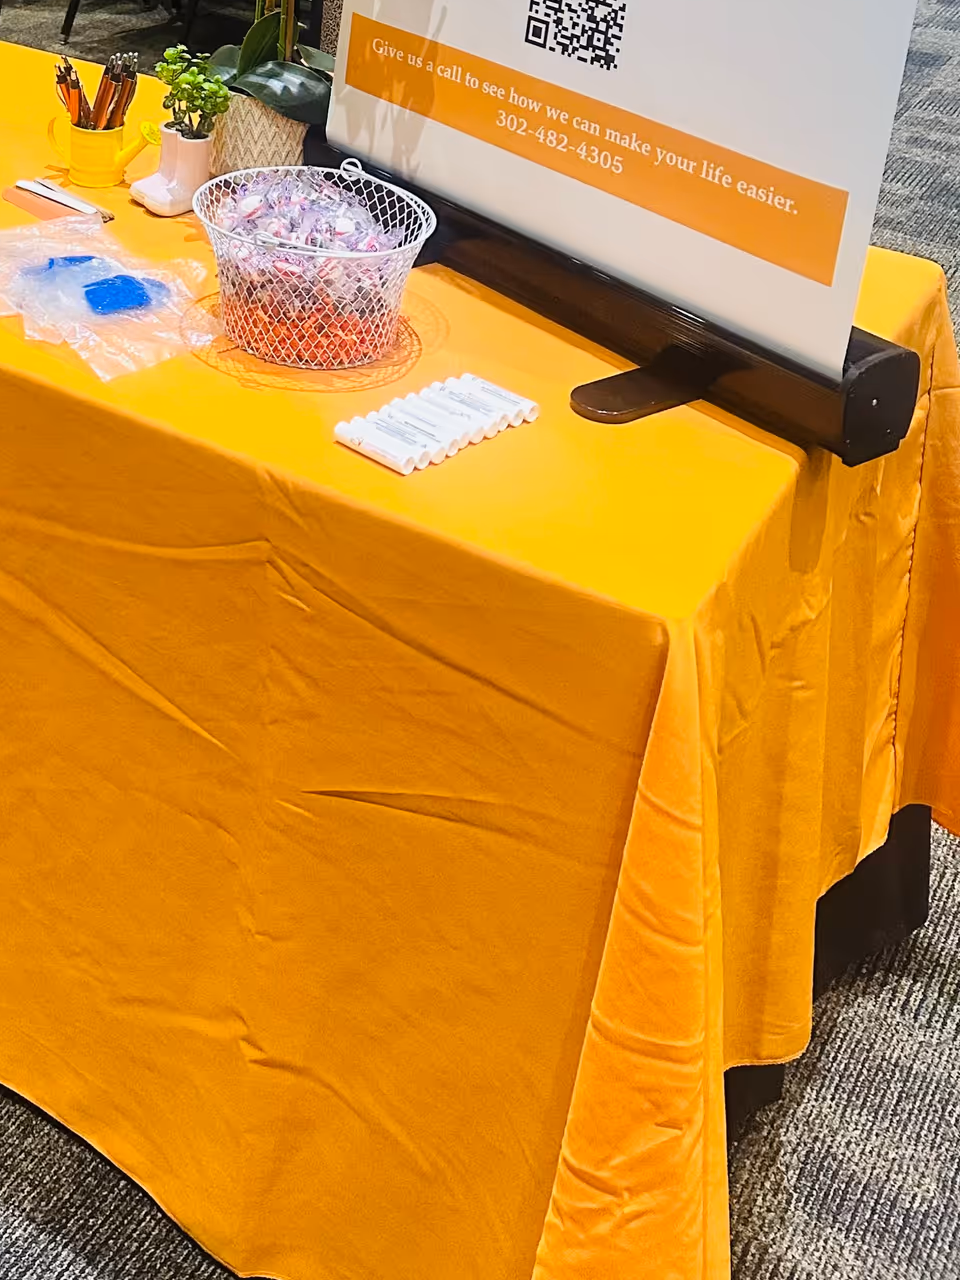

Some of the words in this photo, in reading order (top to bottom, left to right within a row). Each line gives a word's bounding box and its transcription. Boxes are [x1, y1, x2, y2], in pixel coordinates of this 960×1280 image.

[372, 38, 404, 63] Give
[407, 50, 423, 67] us
[426, 59, 434, 72] a
[436, 61, 462, 84] call
[465, 73, 479, 89] to
[482, 79, 506, 100] see
[508, 85, 542, 113] how
[546, 103, 569, 124] we
[572, 113, 601, 135] can
[605, 125, 651, 156] make
[655, 146, 696, 174] your
[701, 161, 732, 188] life
[736, 177, 799, 215] easier.
[496, 110, 624, 175] 302-482-4305
